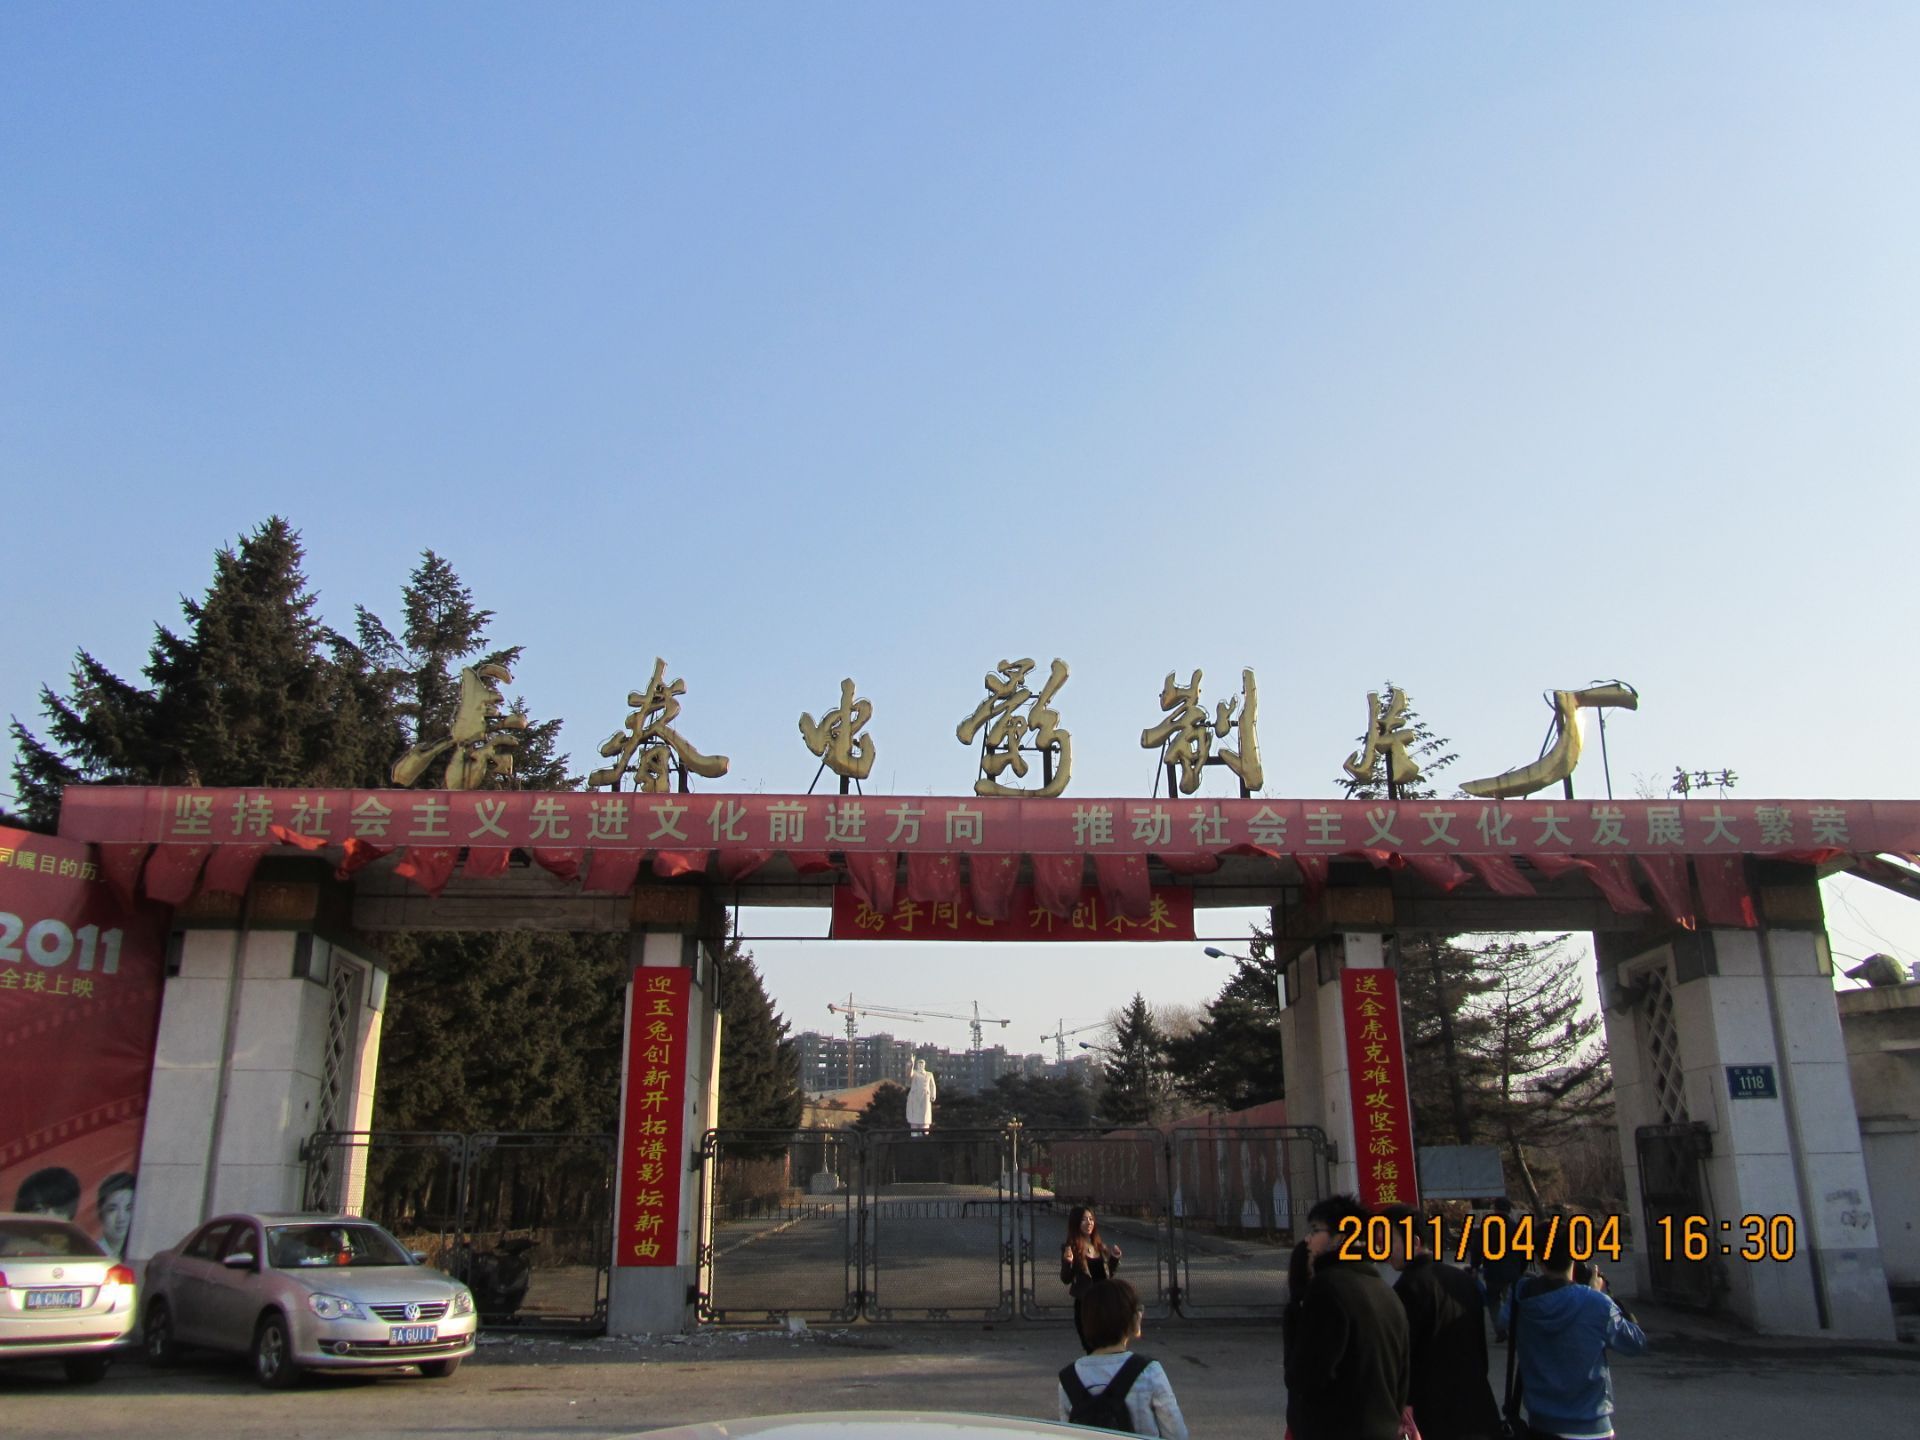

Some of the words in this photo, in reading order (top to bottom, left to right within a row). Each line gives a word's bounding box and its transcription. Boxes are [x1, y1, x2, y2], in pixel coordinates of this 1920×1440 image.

[173, 795, 985, 846] 坚持社会主义先进文化前进方向
[1071, 803, 1853, 847] 推动社会主义文化大发展大繁荣
[0, 911, 124, 975] 2011
[0, 968, 94, 998] 全球上映
[1739, 1075, 1765, 1090] 1118
[633, 975, 677, 1259] 迎玉兔创新开拓谱影坛新曲
